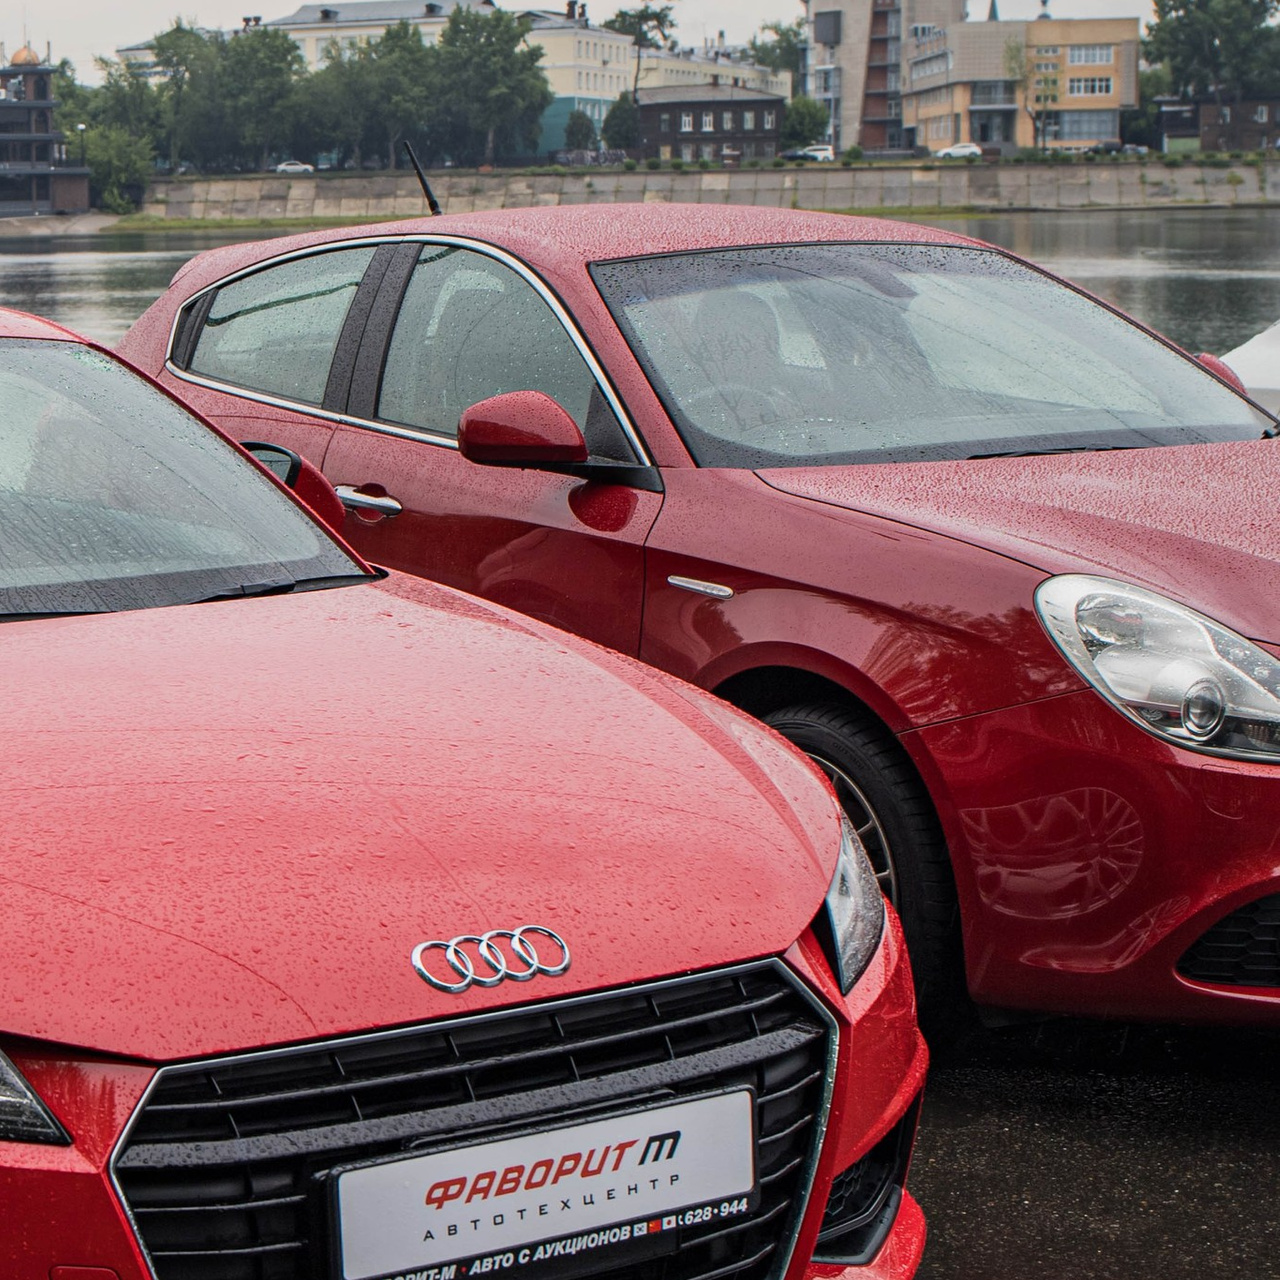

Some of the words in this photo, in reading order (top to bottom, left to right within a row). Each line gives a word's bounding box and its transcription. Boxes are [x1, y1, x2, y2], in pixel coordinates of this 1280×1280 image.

[423, 1174, 680, 1241] АВТОТЕХЦЕНТР
[425, 1139, 640, 1210] ФАВОРИТ
[469, 1252, 514, 1276] АВТО
[518, 1249, 531, 1264] С
[532, 1225, 631, 1262] АУКЦИОНОВ
